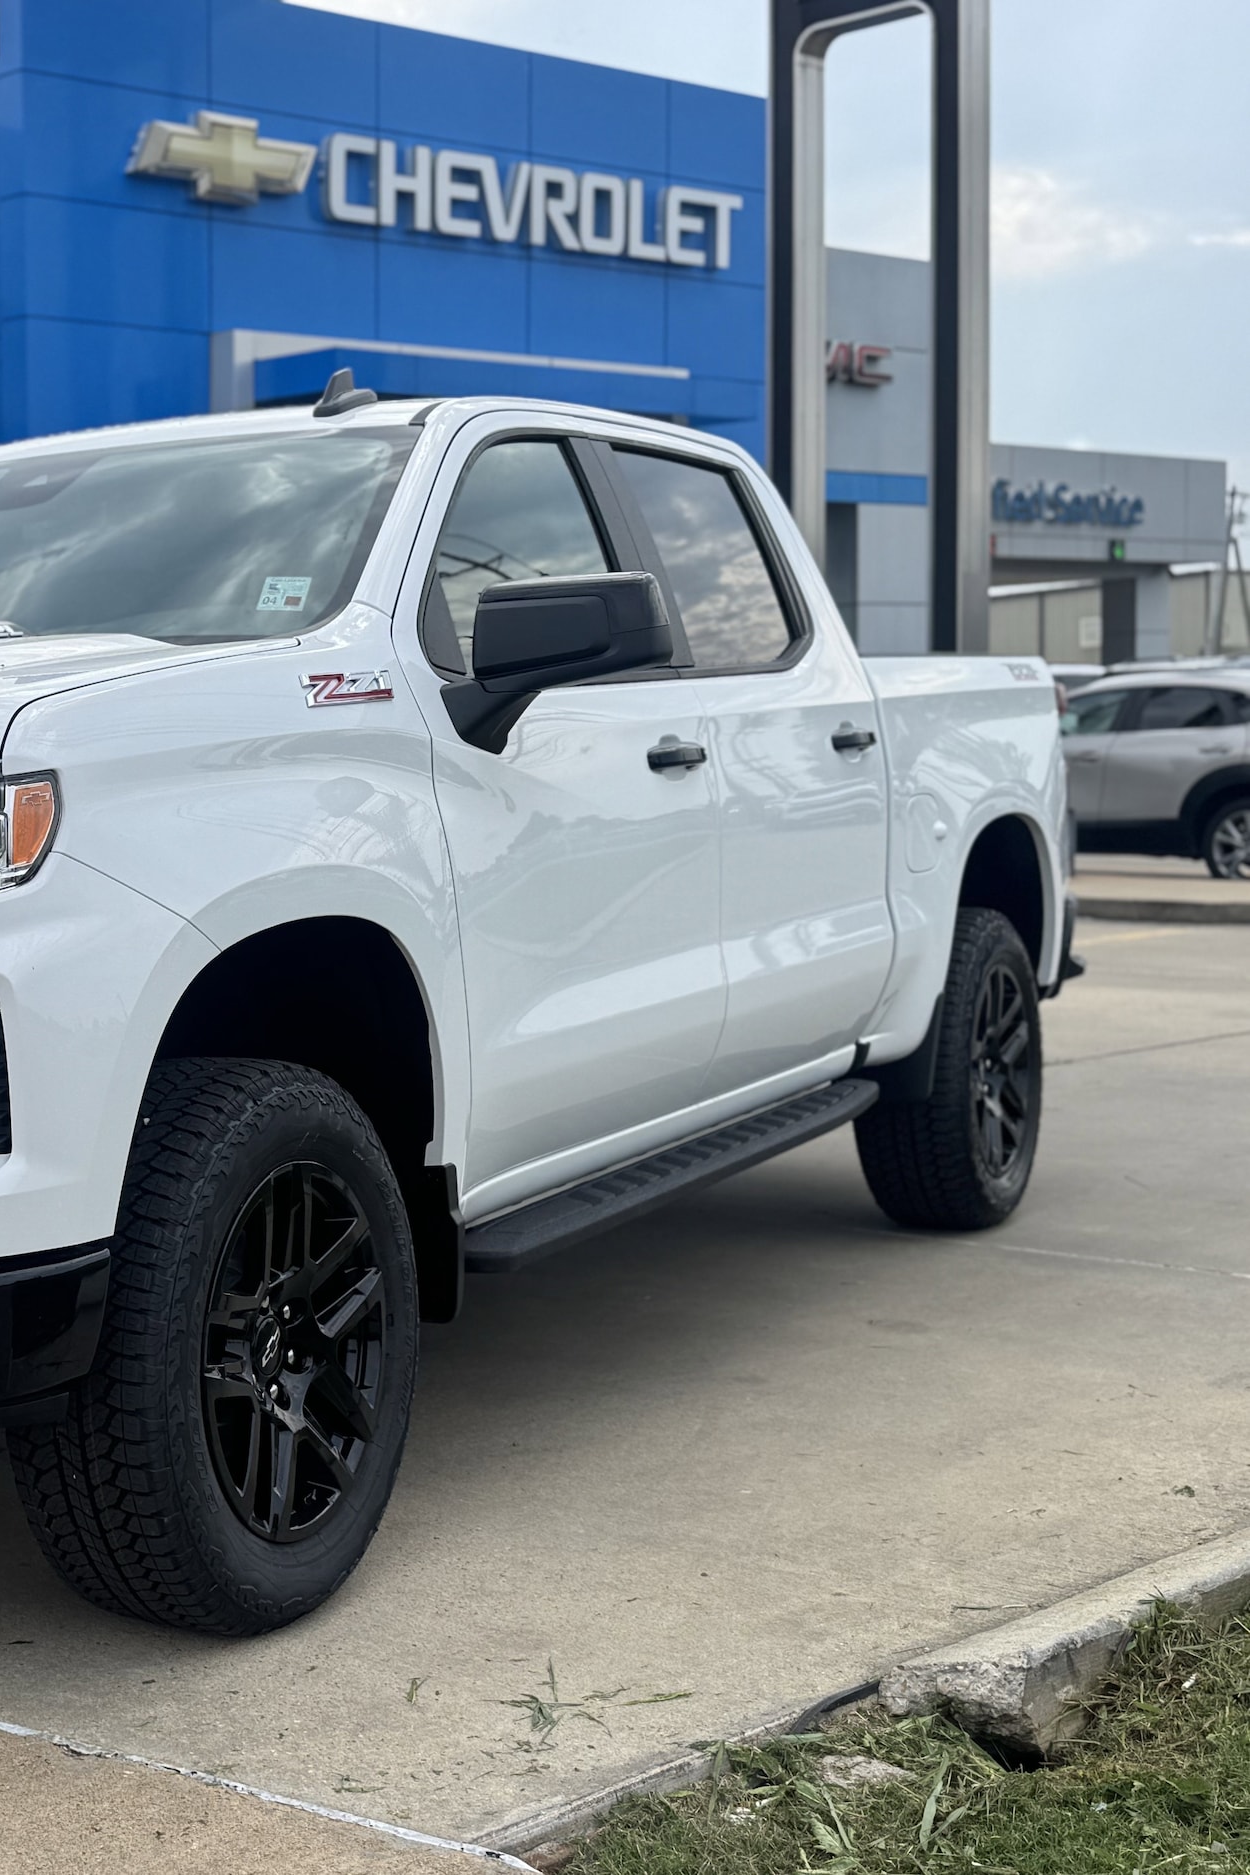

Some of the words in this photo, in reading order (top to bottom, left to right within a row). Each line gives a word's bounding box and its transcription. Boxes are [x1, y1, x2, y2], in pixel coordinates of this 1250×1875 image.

[323, 132, 744, 270] CHEVROLET
[1048, 482, 1144, 526] Service
[262, 596, 278, 606] 04
[299, 669, 395, 708] Z71
